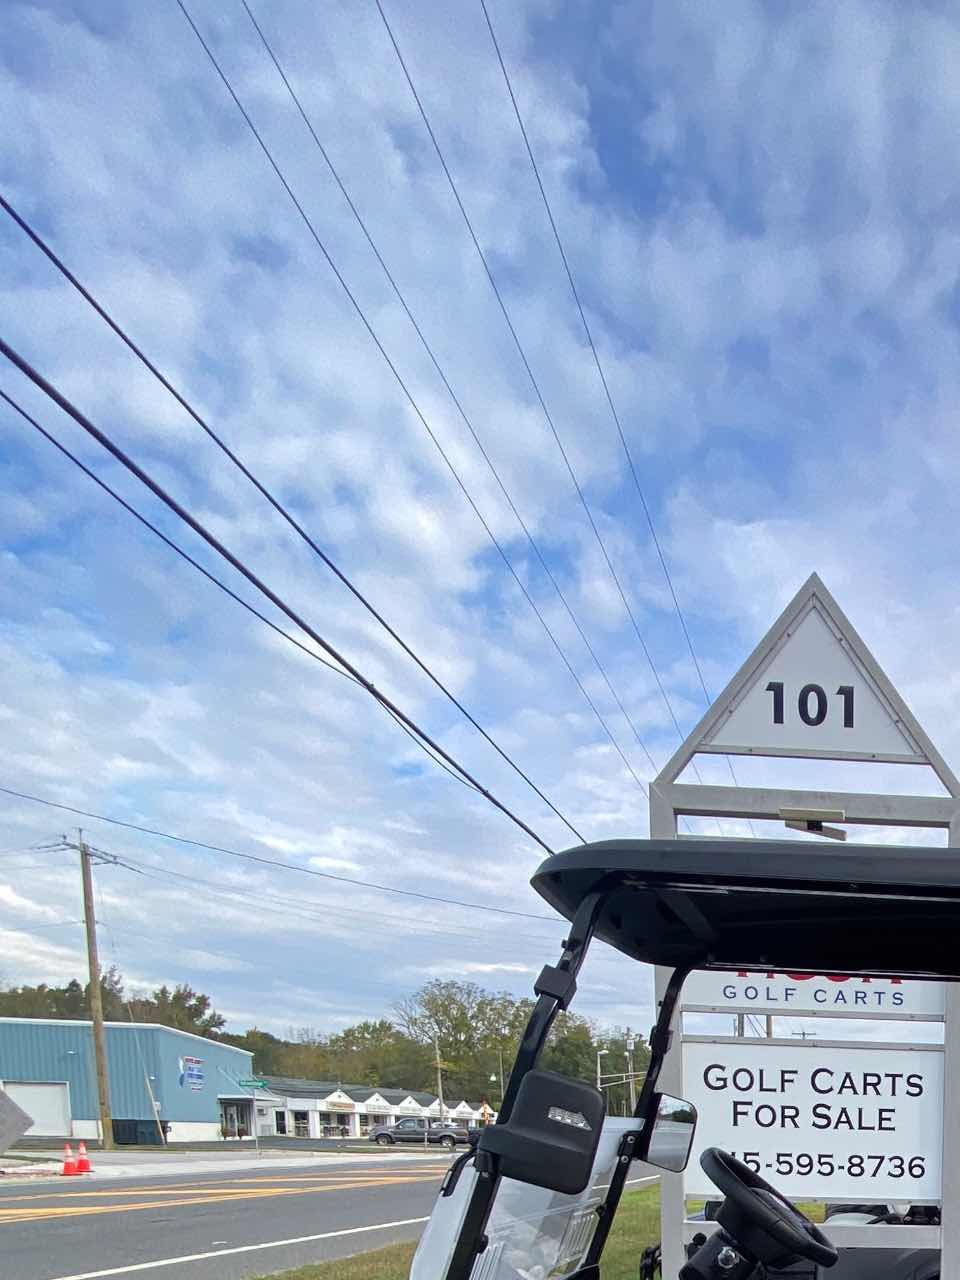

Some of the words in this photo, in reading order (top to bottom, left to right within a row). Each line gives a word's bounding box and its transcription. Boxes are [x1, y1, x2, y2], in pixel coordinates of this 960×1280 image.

[765, 682, 854, 728] 101
[724, 985, 797, 1001] GOLF
[814, 989, 904, 1006] CARTS
[704, 1063, 798, 1093] GOLF
[810, 1068, 923, 1097] CARTS
[732, 1101, 800, 1128] FOR
[811, 1103, 896, 1132] SALE
[730, 1151, 926, 1179] 5-595-8736
